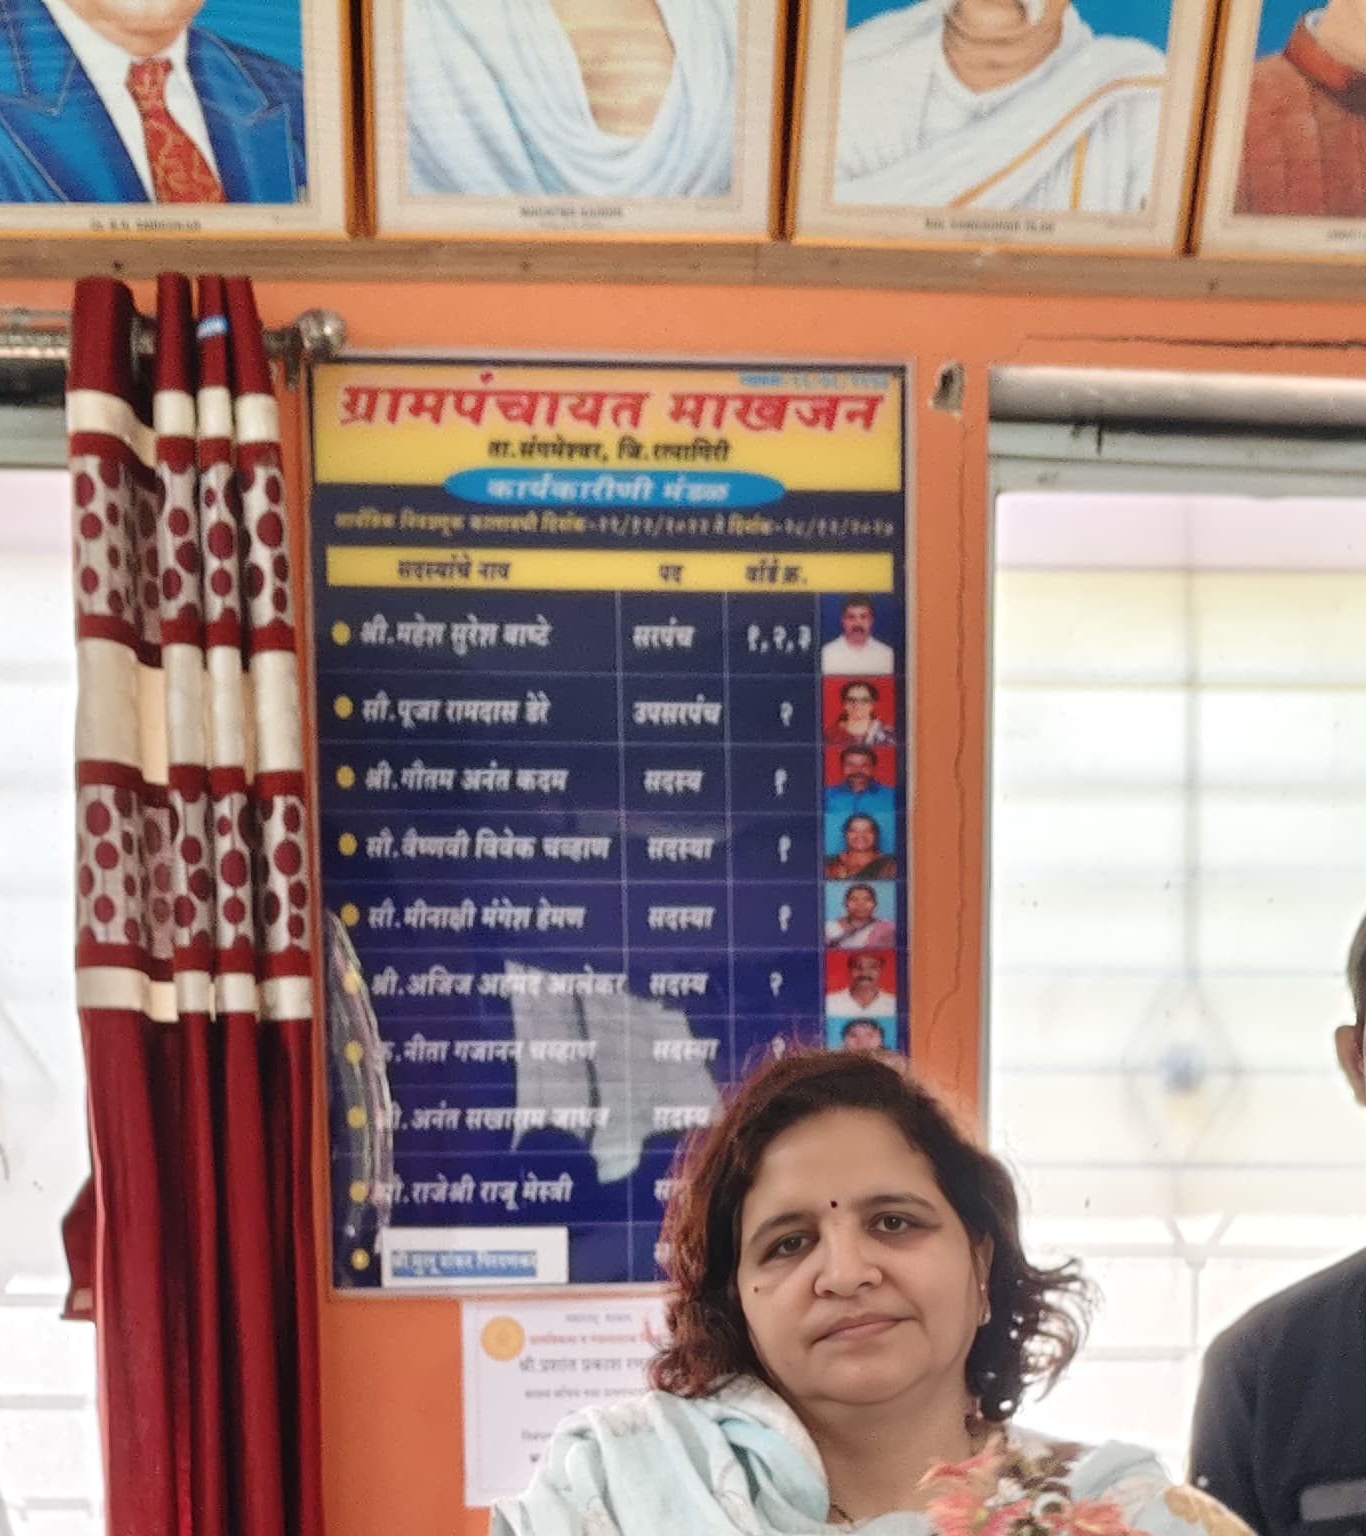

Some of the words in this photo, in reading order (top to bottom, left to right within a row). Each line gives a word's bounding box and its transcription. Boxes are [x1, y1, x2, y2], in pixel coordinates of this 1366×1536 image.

[338, 372, 649, 431] ग्रामपंचायत
[668, 391, 885, 432] माखजन
[477, 561, 511, 580] नाव
[658, 562, 684, 584] पद
[450, 612, 500, 656] सुरेश
[632, 615, 696, 648] सरपंच
[444, 698, 522, 724] रामदास
[632, 692, 724, 727] उपसरपंच
[460, 759, 513, 792] अनंत
[515, 768, 570, 793] कदम
[643, 768, 704, 795] सदस्य
[475, 825, 537, 860] विवेक
[541, 835, 612, 863] चव्हाण
[647, 836, 715, 862] सदस्या
[480, 896, 533, 931] मंगेश
[647, 905, 716, 932] सदस्या
[649, 971, 710, 998] सदस्य
[453, 1039, 524, 1063] गजानन
[651, 1038, 721, 1065] सदस्या
[480, 1179, 520, 1211] राजू
